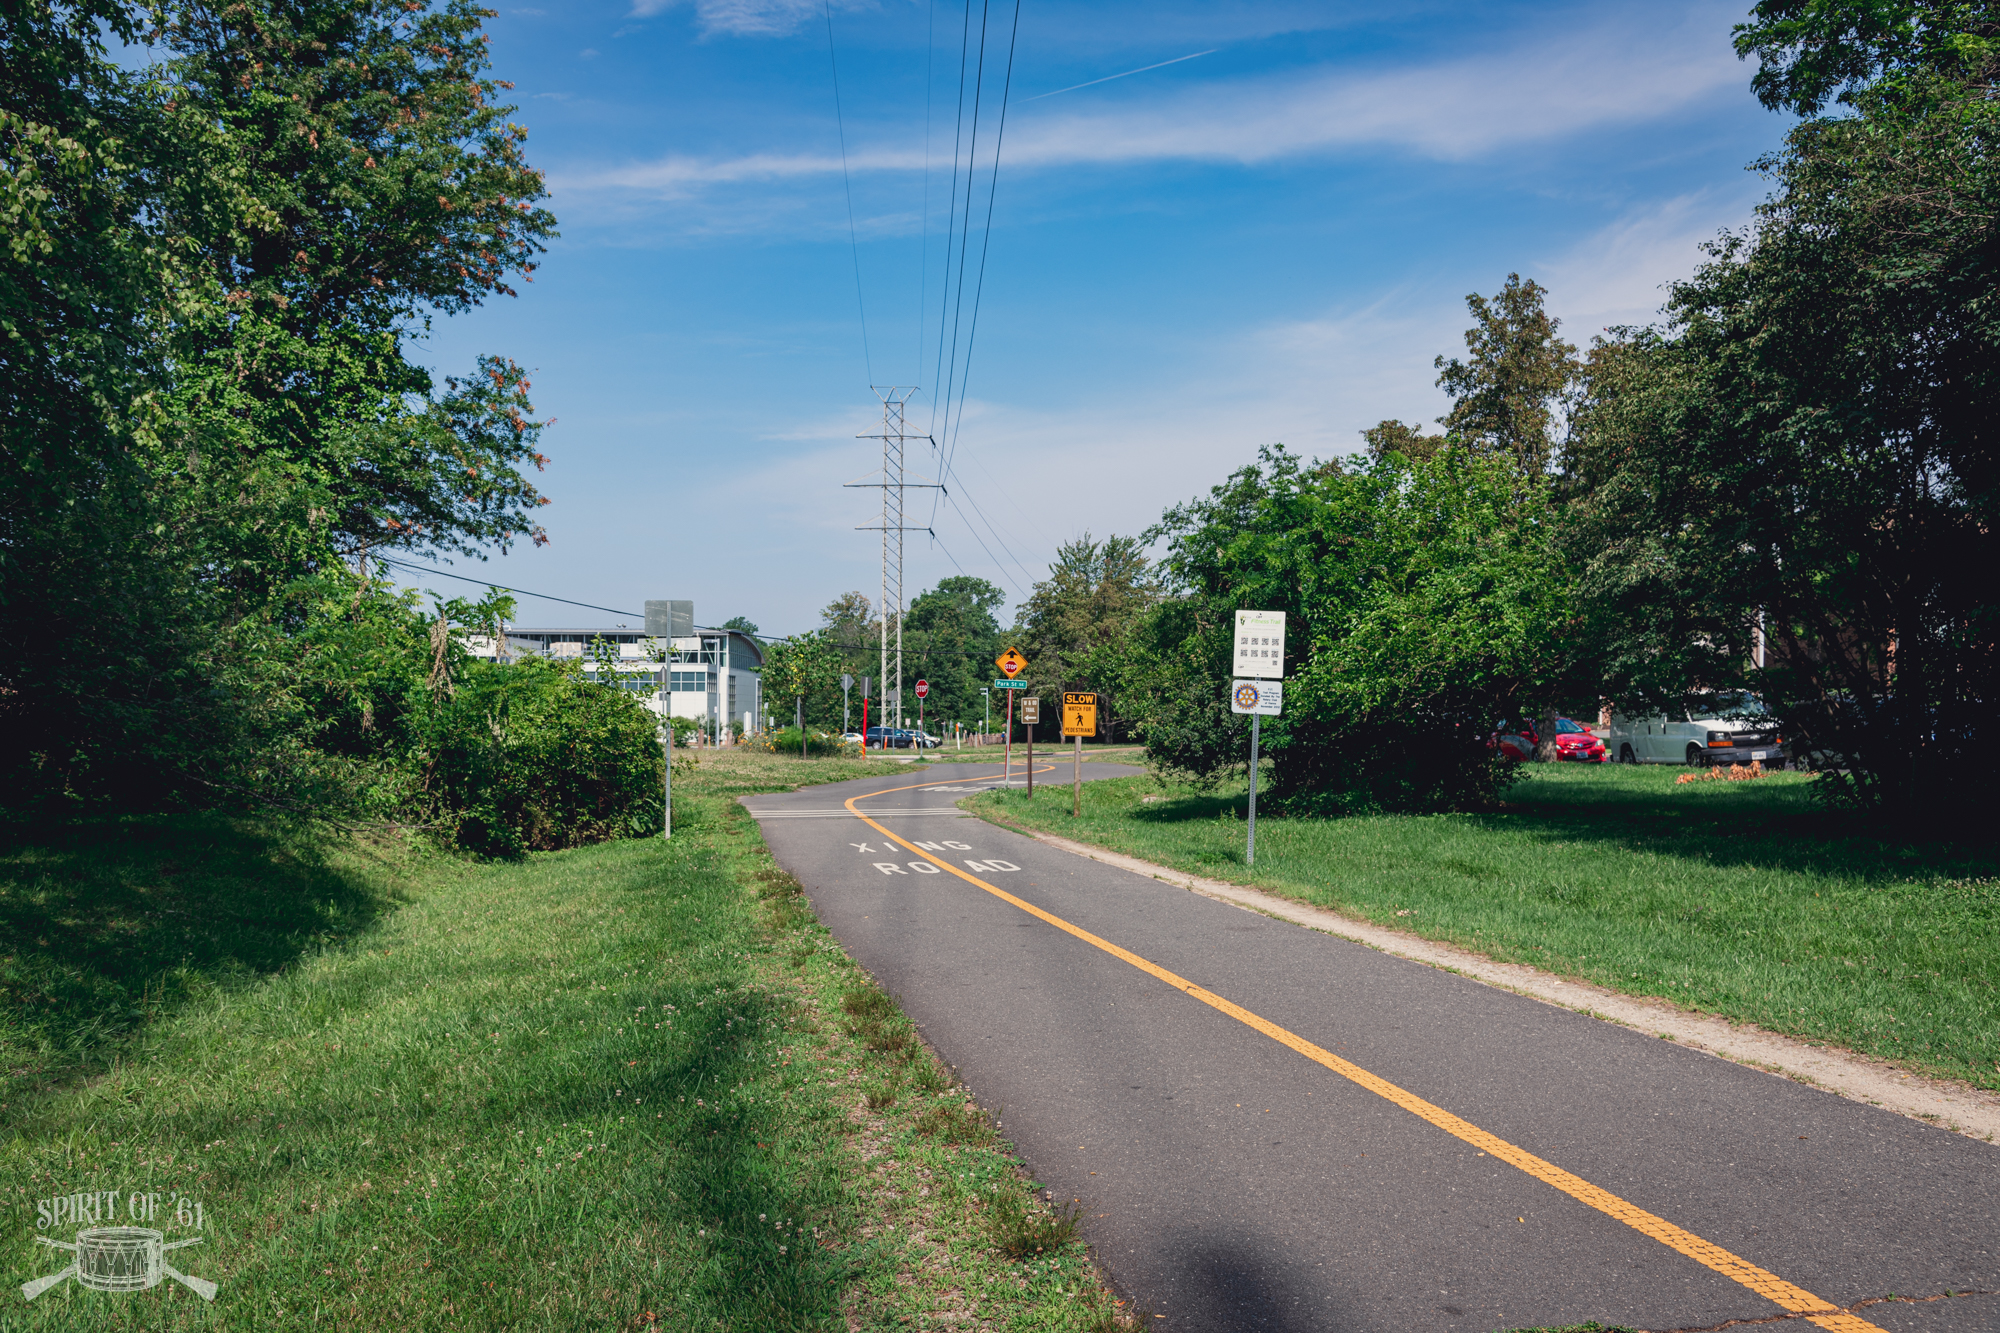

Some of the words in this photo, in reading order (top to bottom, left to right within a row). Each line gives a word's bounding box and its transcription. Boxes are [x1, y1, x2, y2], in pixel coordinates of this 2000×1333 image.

[1066, 695, 1094, 704] SLOW
[849, 840, 972, 853] XING
[872, 859, 1021, 875] ROAD
